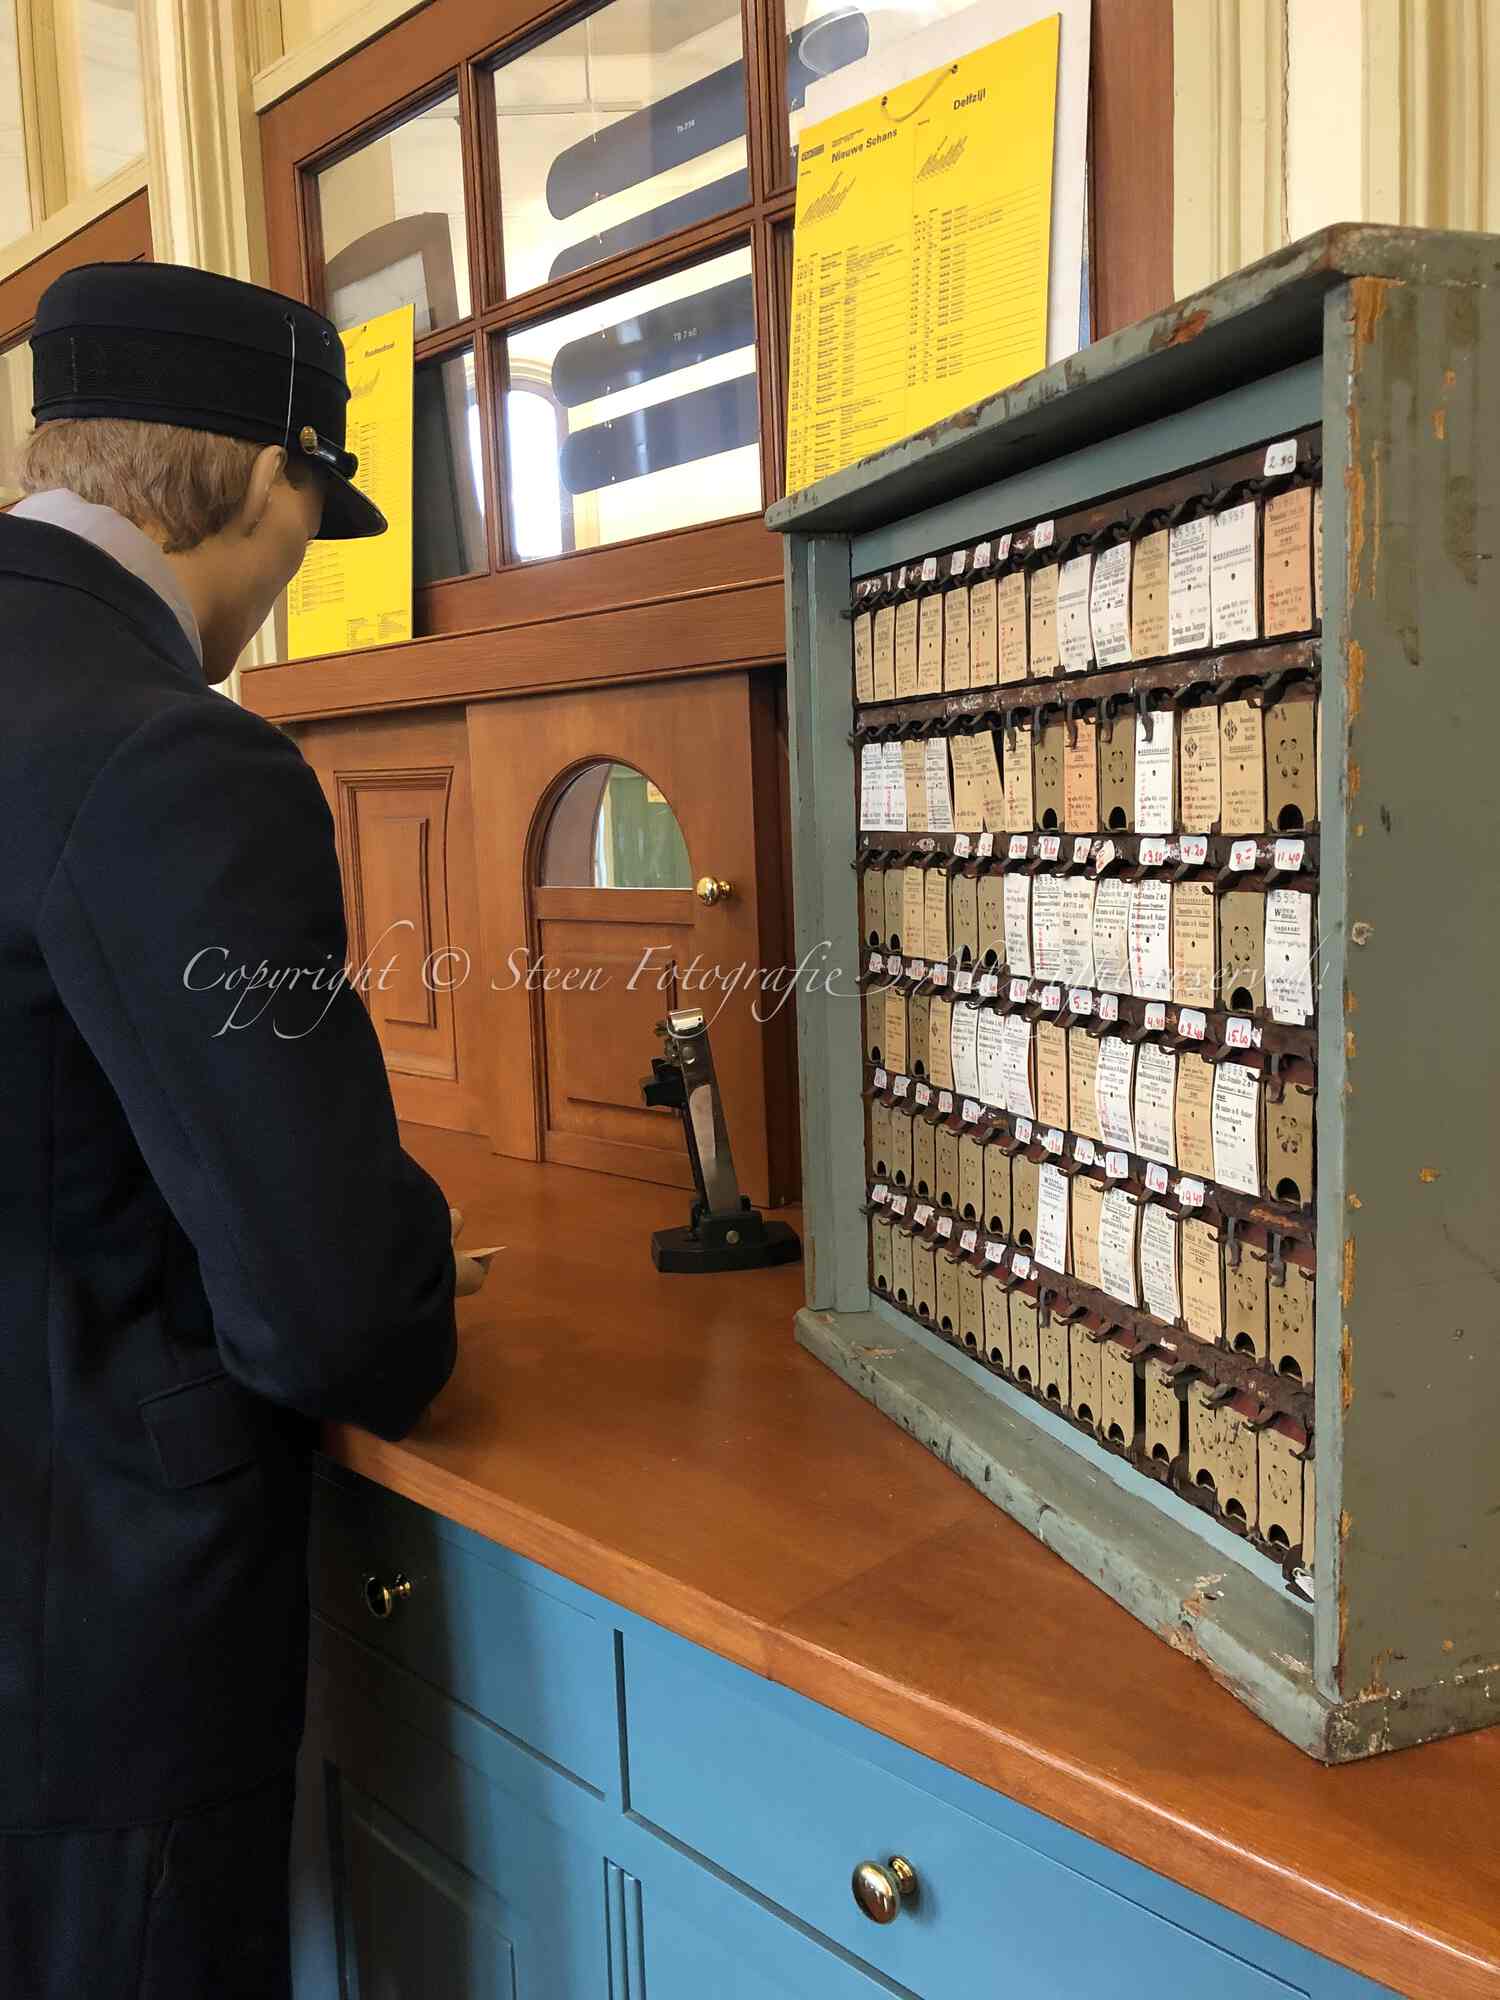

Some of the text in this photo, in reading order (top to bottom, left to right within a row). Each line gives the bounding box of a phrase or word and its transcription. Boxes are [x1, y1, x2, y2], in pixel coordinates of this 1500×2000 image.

[953, 88, 987, 110] Delfzijl
[832, 143, 864, 163] Nieuwe
[866, 128, 898, 149] Schans
